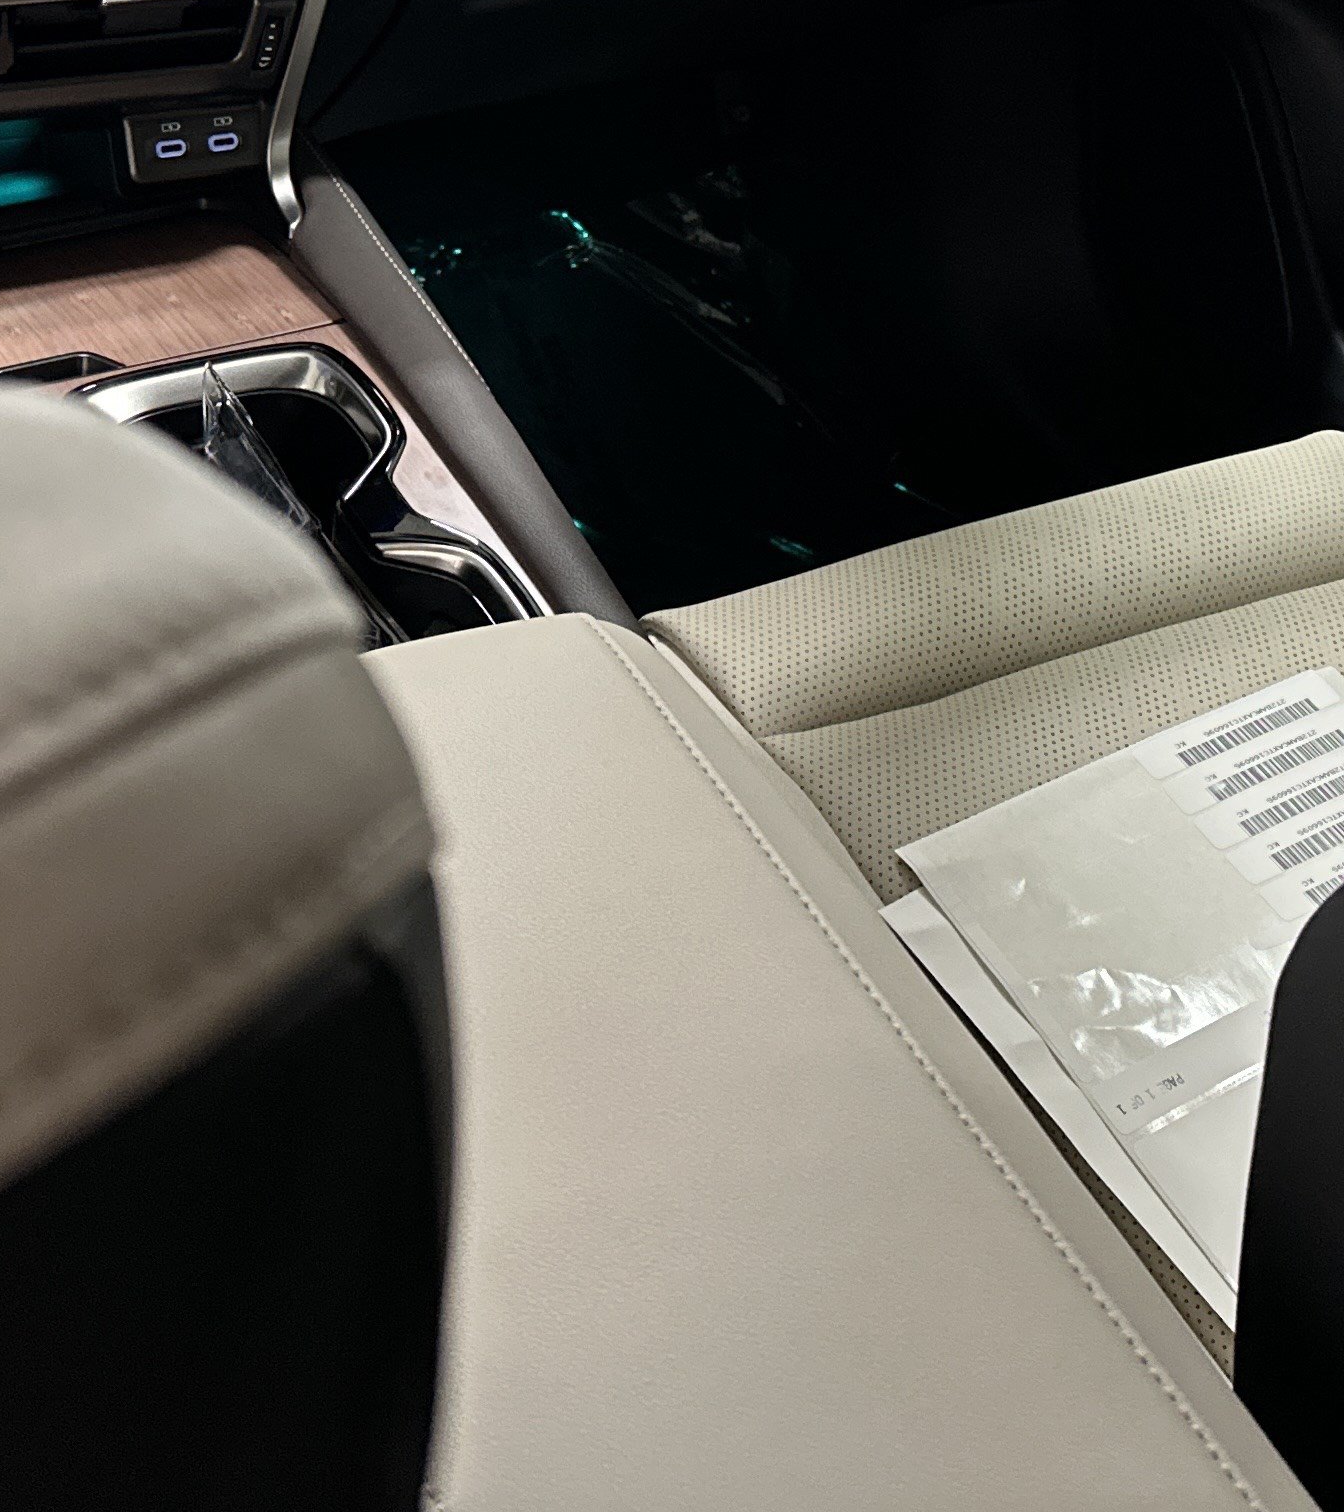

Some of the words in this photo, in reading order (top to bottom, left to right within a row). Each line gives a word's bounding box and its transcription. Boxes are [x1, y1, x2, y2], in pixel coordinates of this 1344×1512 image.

[1175, 741, 1187, 749] KC
[1237, 809, 1250, 818] KC
[1267, 842, 1280, 851] KC
[1302, 878, 1315, 887] KC
[1116, 1103, 1127, 1115] 1
